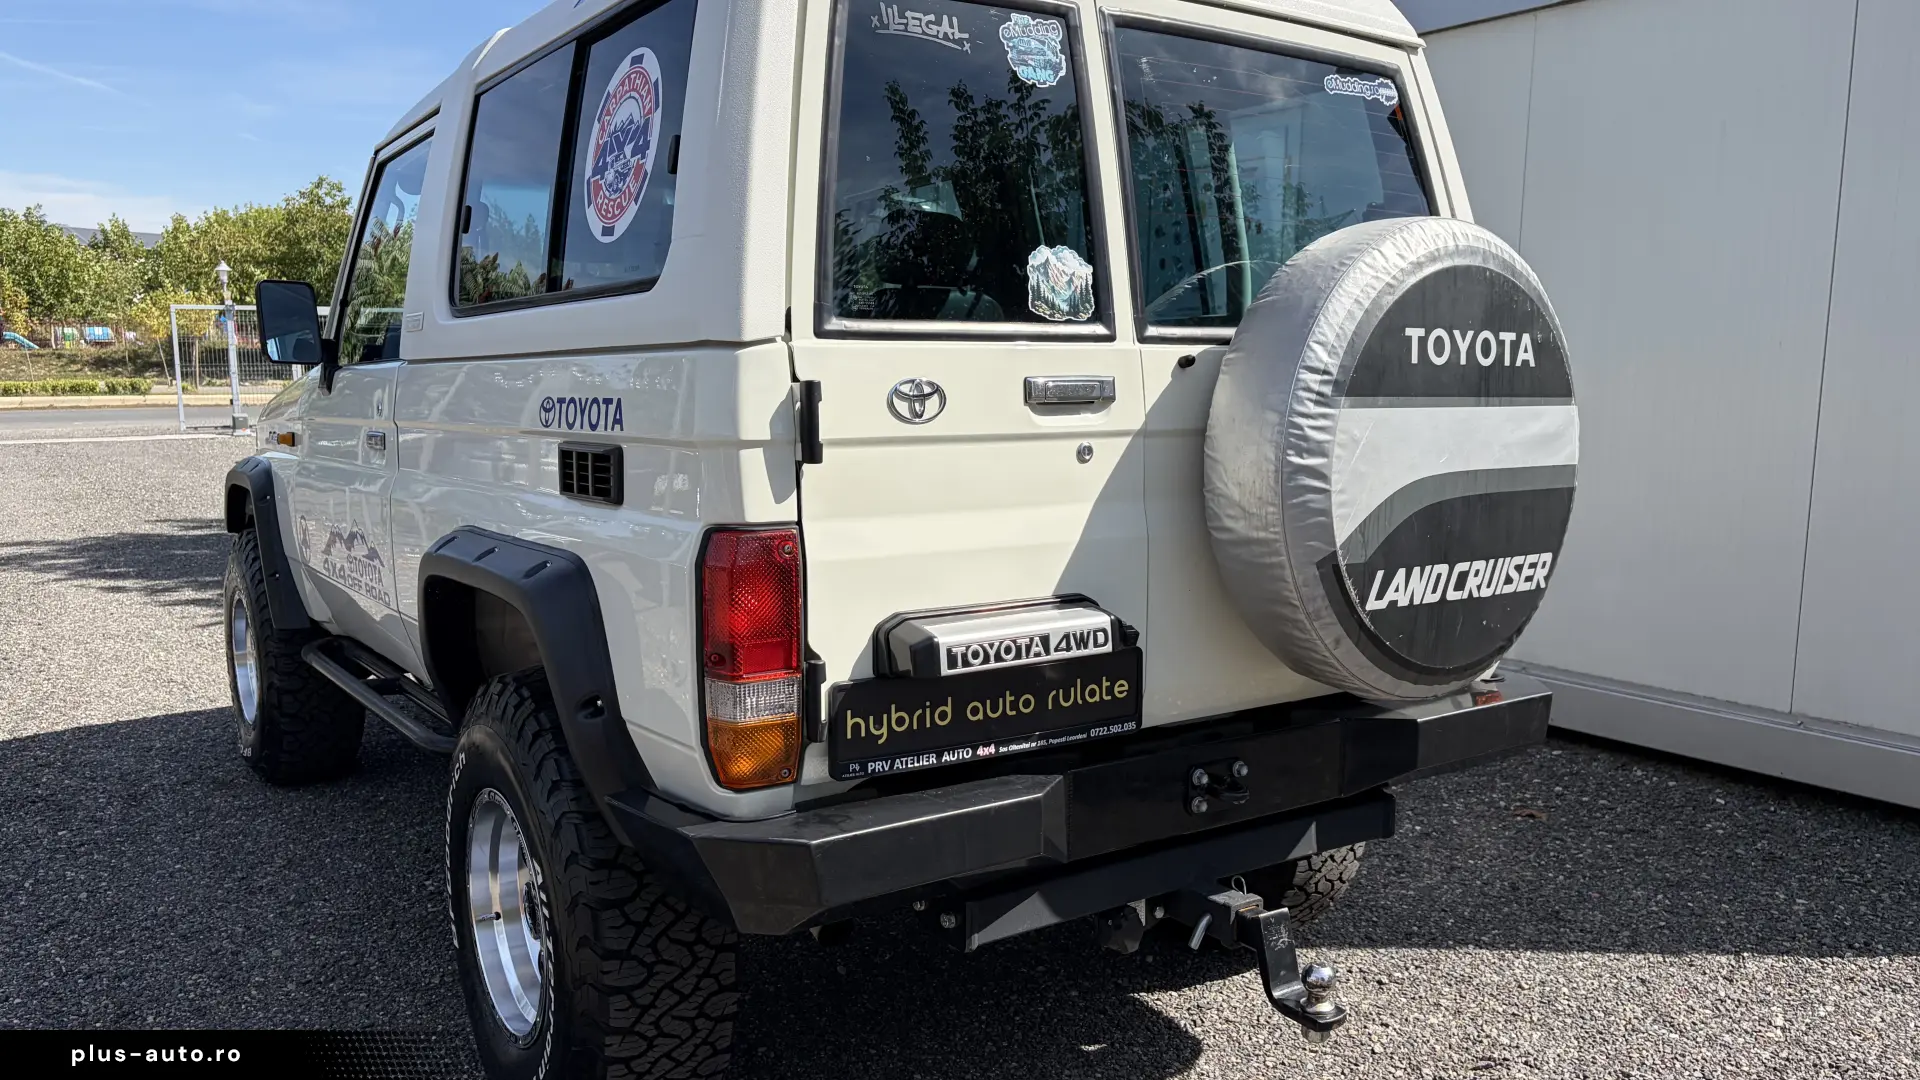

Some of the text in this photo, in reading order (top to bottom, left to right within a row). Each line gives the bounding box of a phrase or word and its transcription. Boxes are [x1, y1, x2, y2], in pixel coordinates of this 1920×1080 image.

[880, 2, 969, 39] ILLEGAL
[1019, 65, 1055, 83] GANG
[599, 72, 652, 144] CARPATHIAN
[596, 174, 639, 218] RESCUE
[1405, 327, 1536, 368] TOYOTA
[556, 396, 624, 432] TOYOTA
[346, 572, 391, 607] OFF ROAD
[350, 556, 385, 588] TOYOTA
[950, 627, 1110, 669] TOYOTA 4WD
[846, 676, 1130, 745] hybrid auto rulate
[867, 759, 892, 774] PRV
[893, 753, 937, 770] ATELIER
[941, 747, 973, 763] AUTO
[1089, 721, 1137, 738] 0722.502.035
